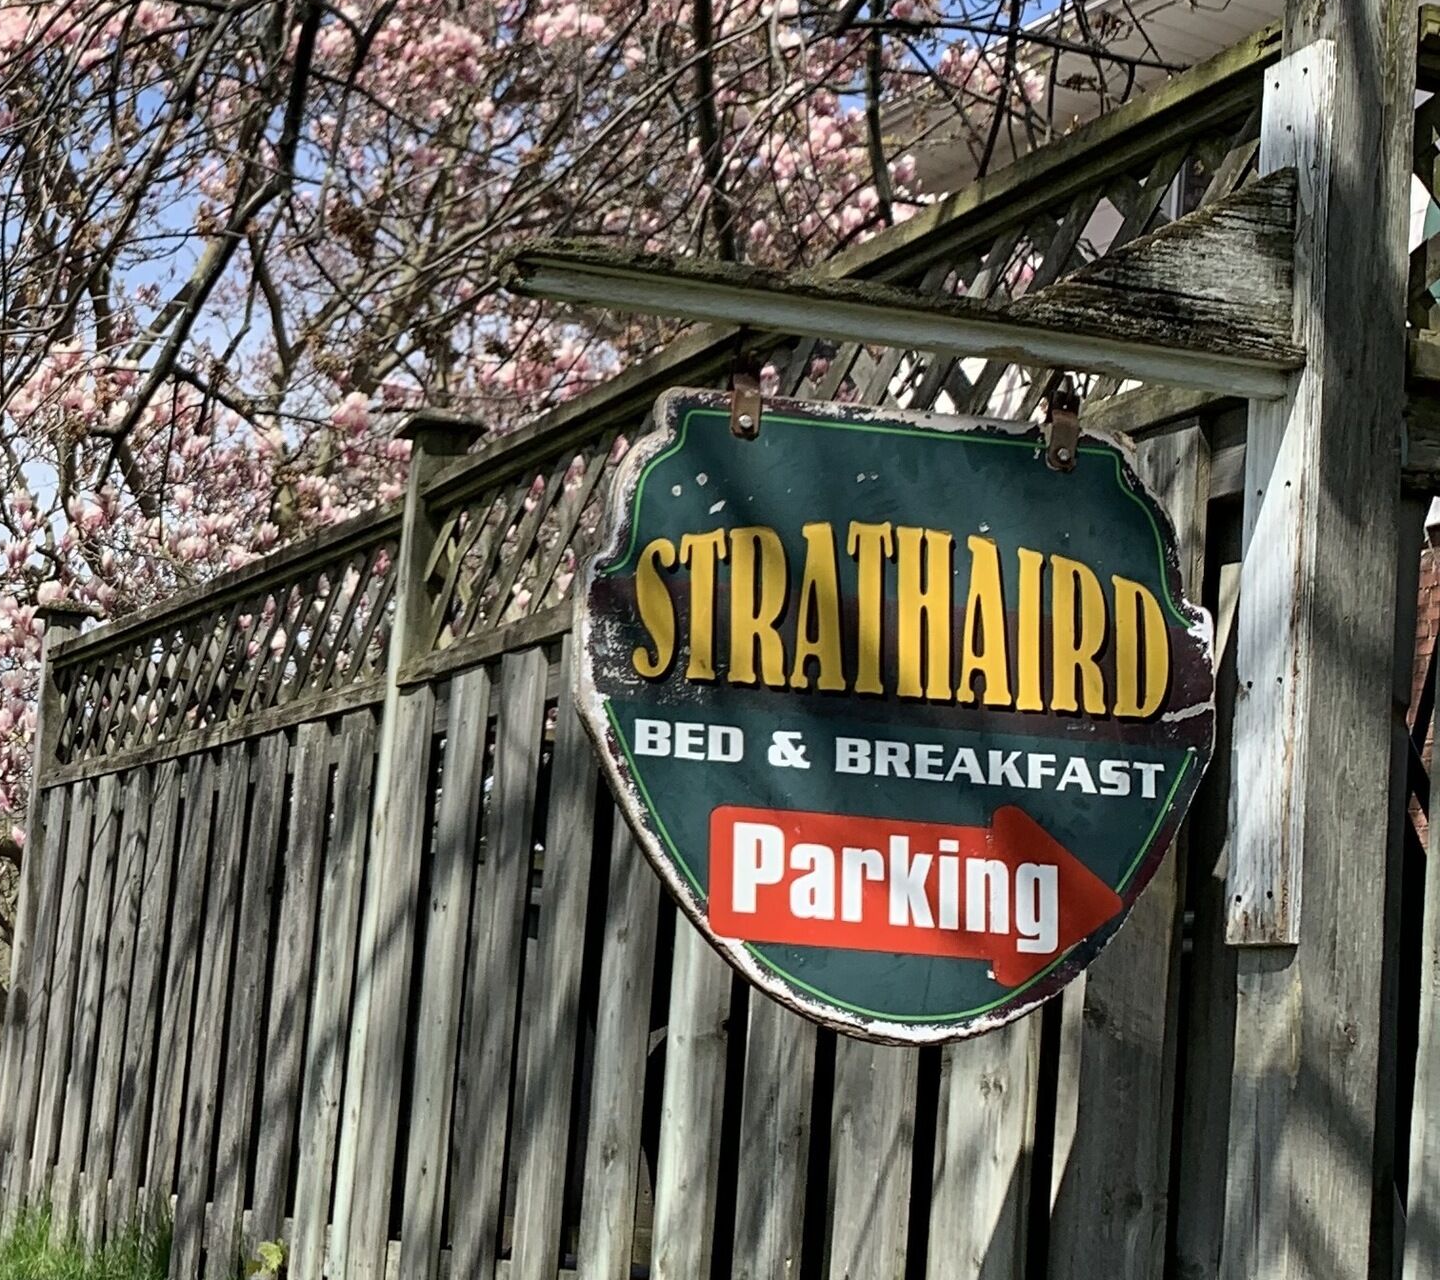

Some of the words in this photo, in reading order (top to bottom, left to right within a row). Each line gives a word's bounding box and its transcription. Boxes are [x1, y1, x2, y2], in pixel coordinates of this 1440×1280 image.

[632, 521, 1169, 718] STRATHAIRD
[634, 718, 744, 763] BED
[767, 730, 811, 769] &
[835, 736, 1165, 799] BREAKFAST
[731, 820, 1059, 954] Parking
